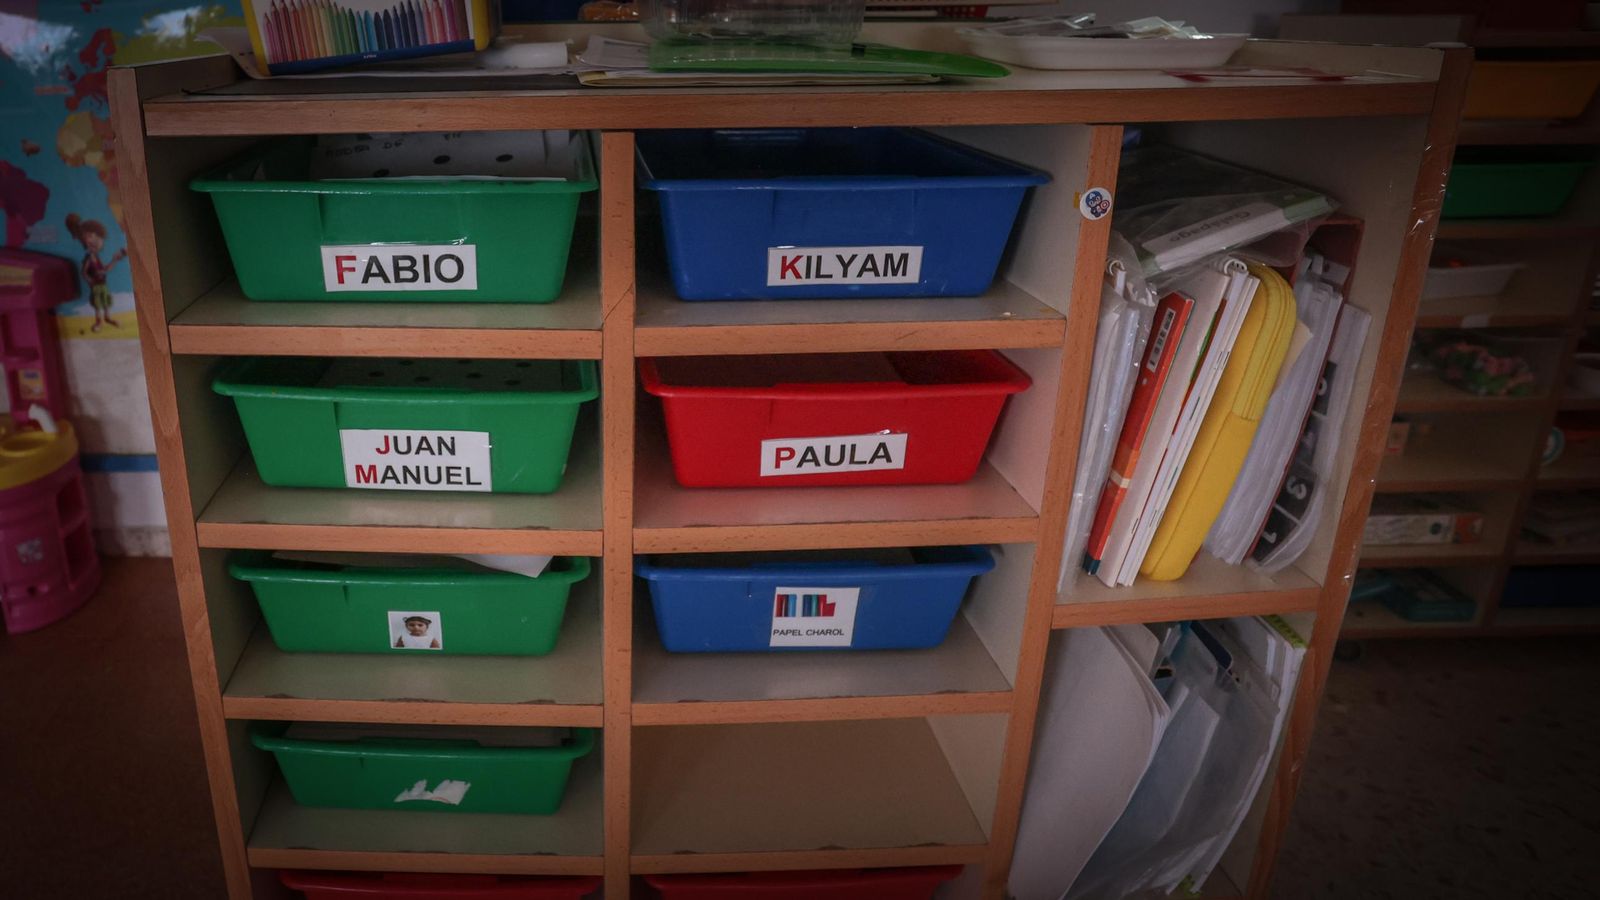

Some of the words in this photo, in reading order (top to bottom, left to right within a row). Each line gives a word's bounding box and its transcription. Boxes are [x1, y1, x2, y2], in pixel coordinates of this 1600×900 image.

[335, 254, 464, 285] FABIO
[780, 252, 910, 280] KILYAM
[375, 434, 455, 456] JUAN
[774, 441, 892, 469] PAULA
[355, 464, 482, 486] MANUEL
[772, 628, 803, 637] PAPEL
[805, 628, 845, 637] CHAROL
